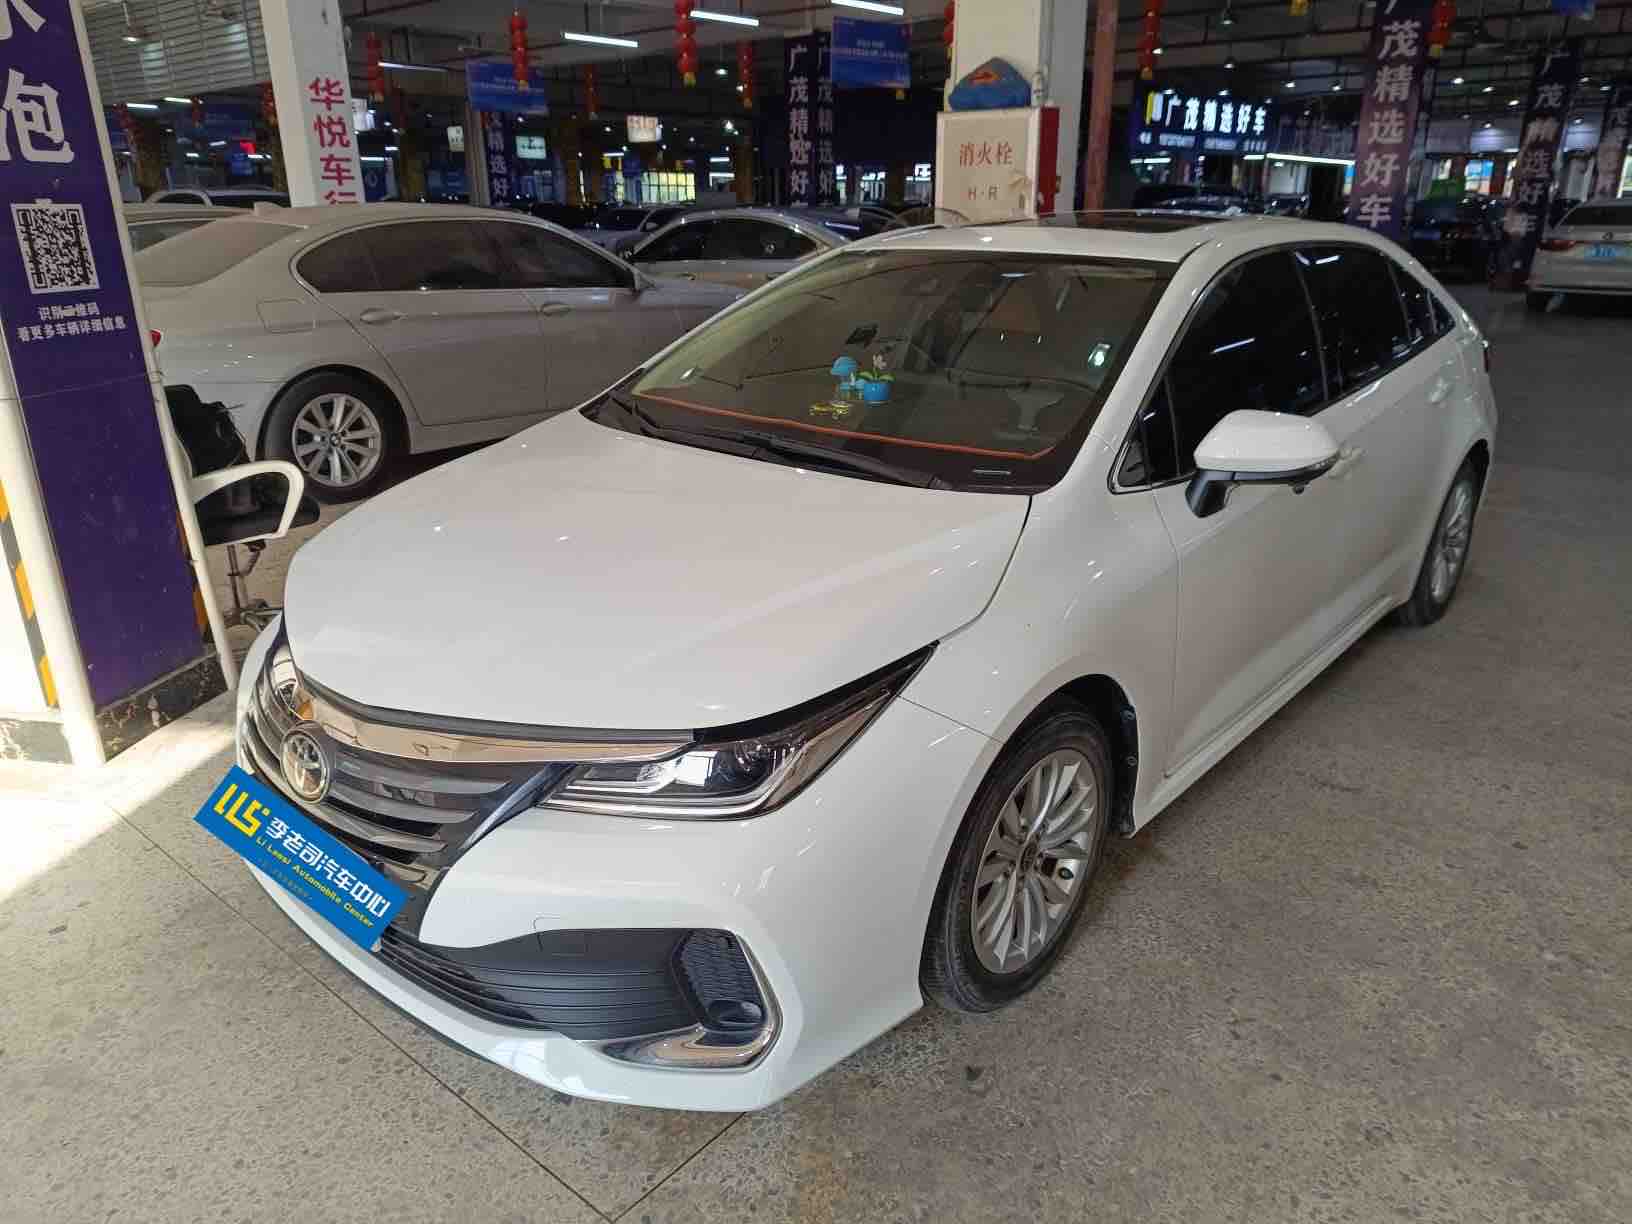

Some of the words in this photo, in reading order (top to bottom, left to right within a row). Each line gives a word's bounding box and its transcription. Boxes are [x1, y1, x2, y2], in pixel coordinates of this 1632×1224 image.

[0, 0, 74, 163] 泡
[960, 140, 1013, 167] 消火栓
